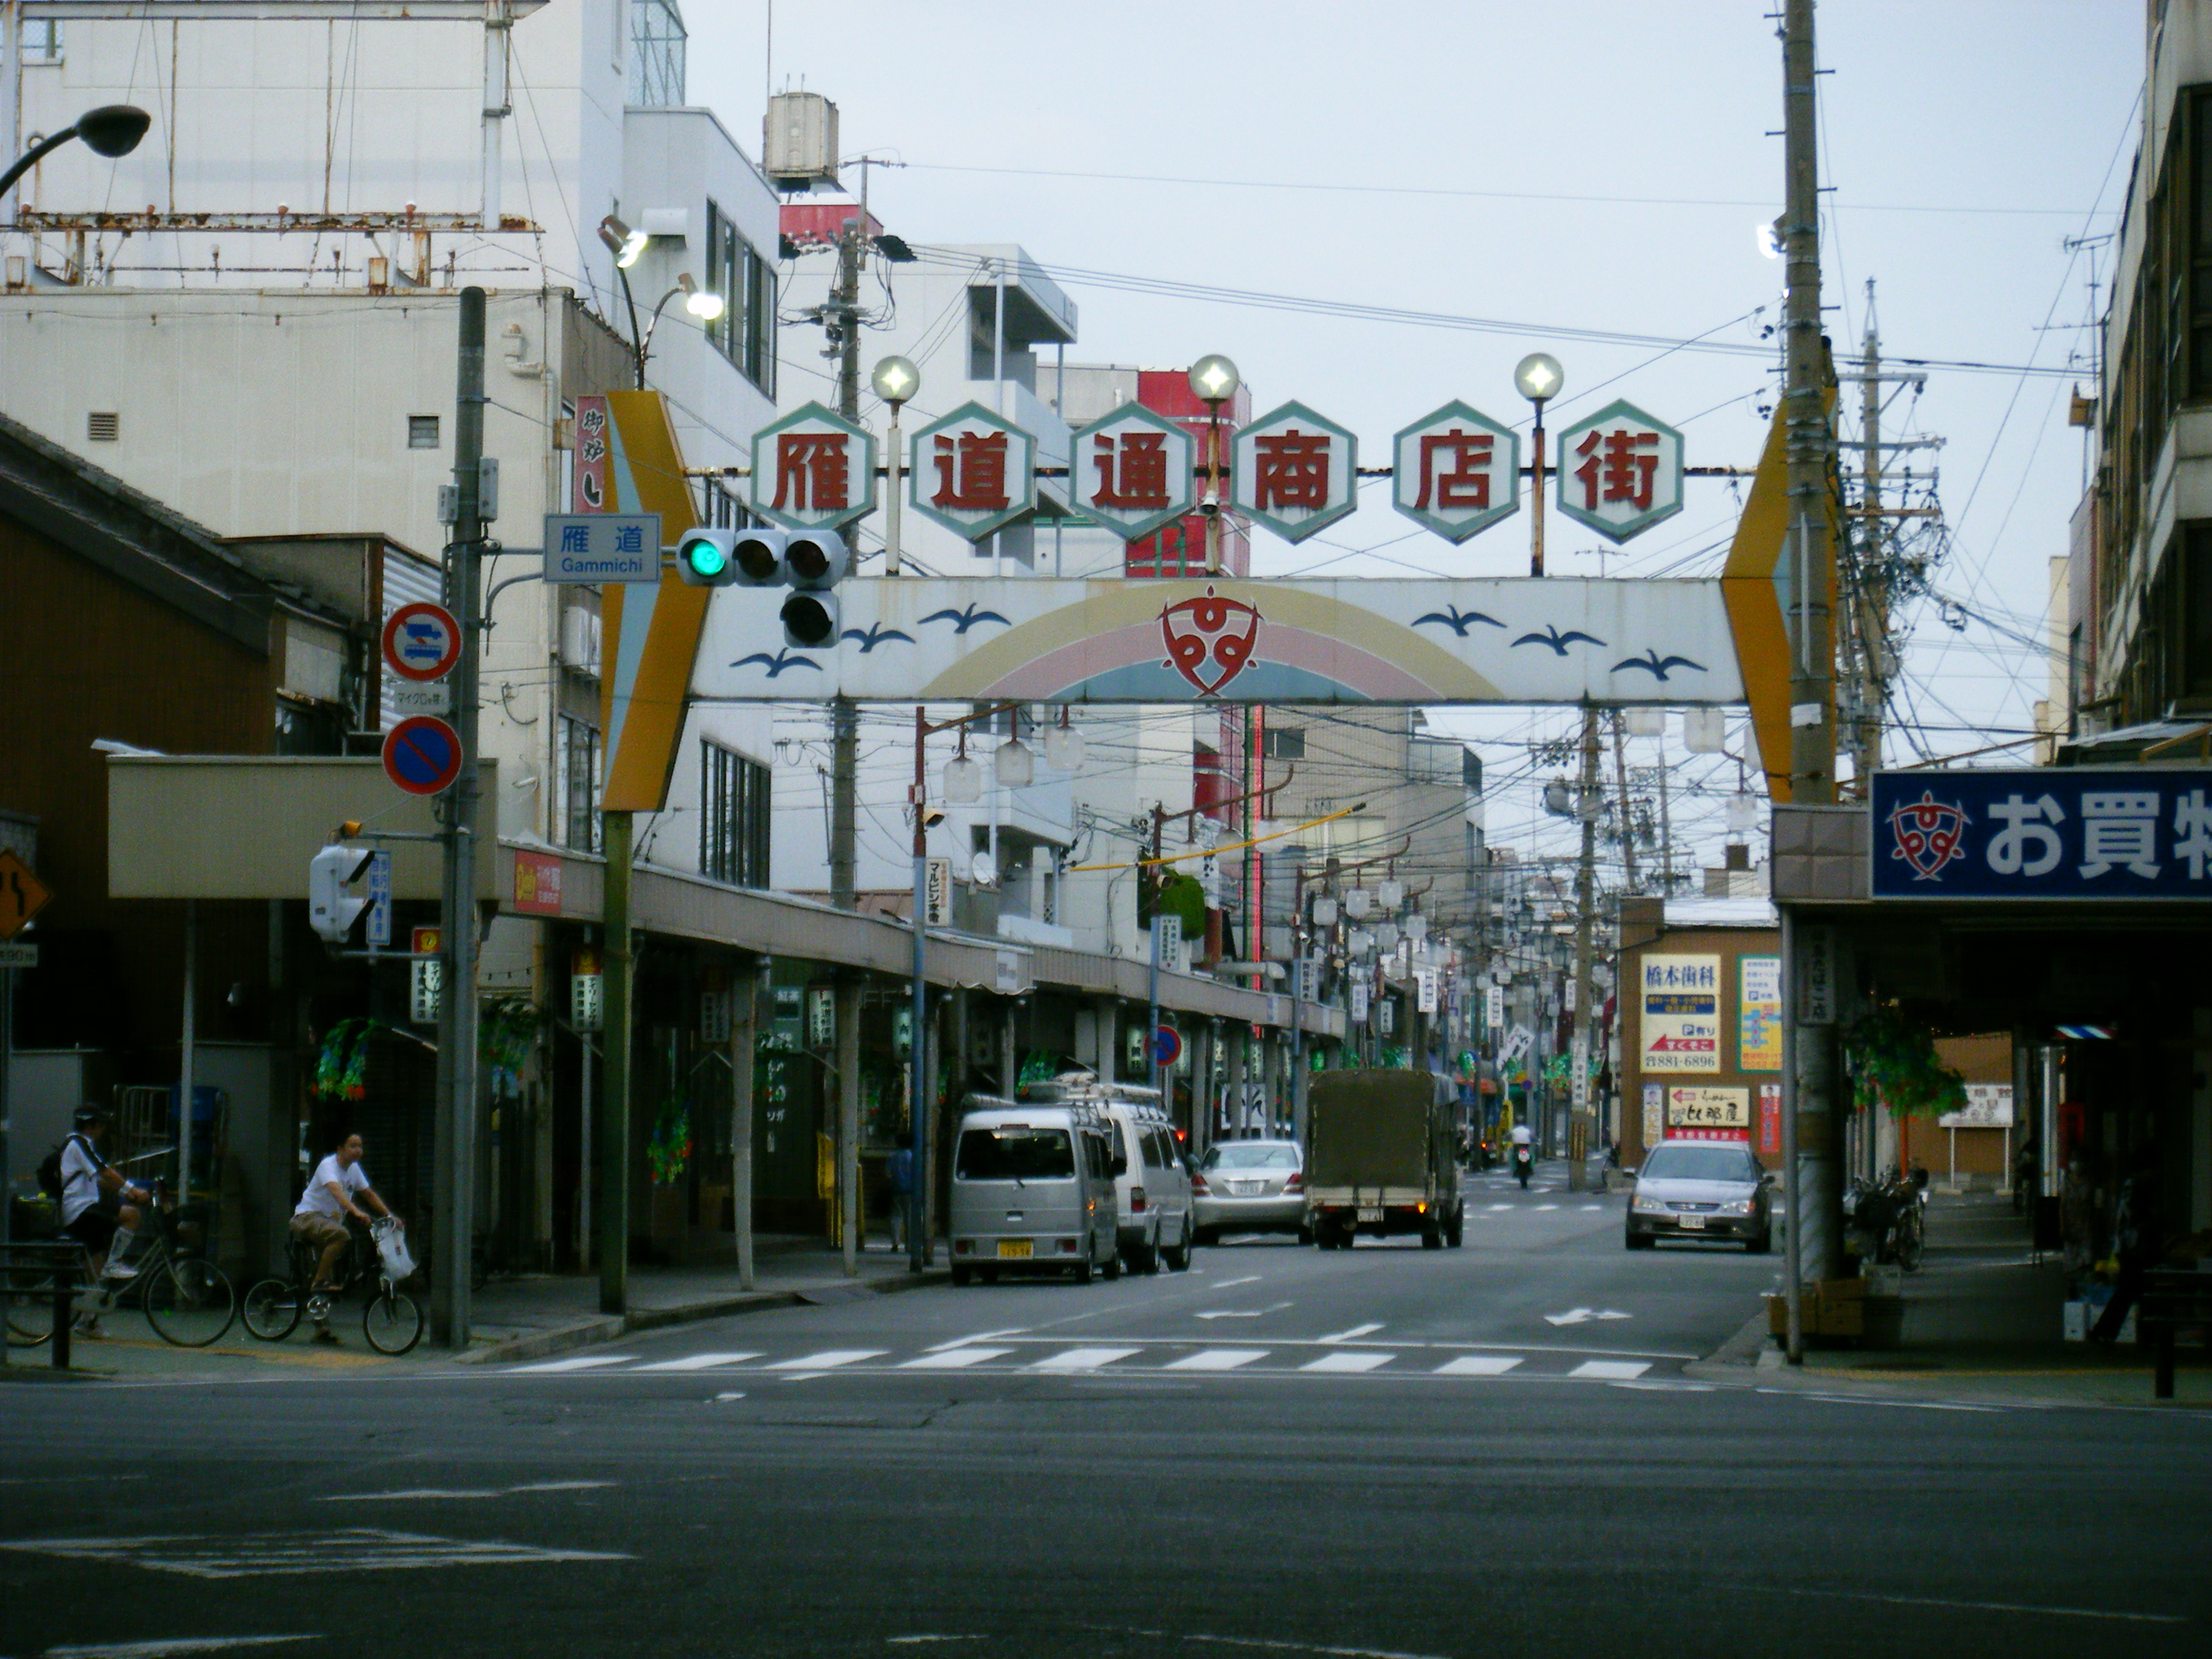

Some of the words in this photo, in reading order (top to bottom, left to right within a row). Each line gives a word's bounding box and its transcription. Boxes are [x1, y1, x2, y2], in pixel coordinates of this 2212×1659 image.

[771, 428, 1660, 510] 雁道通商店街
[560, 525, 644, 554] 雁道
[561, 557, 643, 573] Gammichi
[1645, 964, 1715, 988] 橋本歯科
